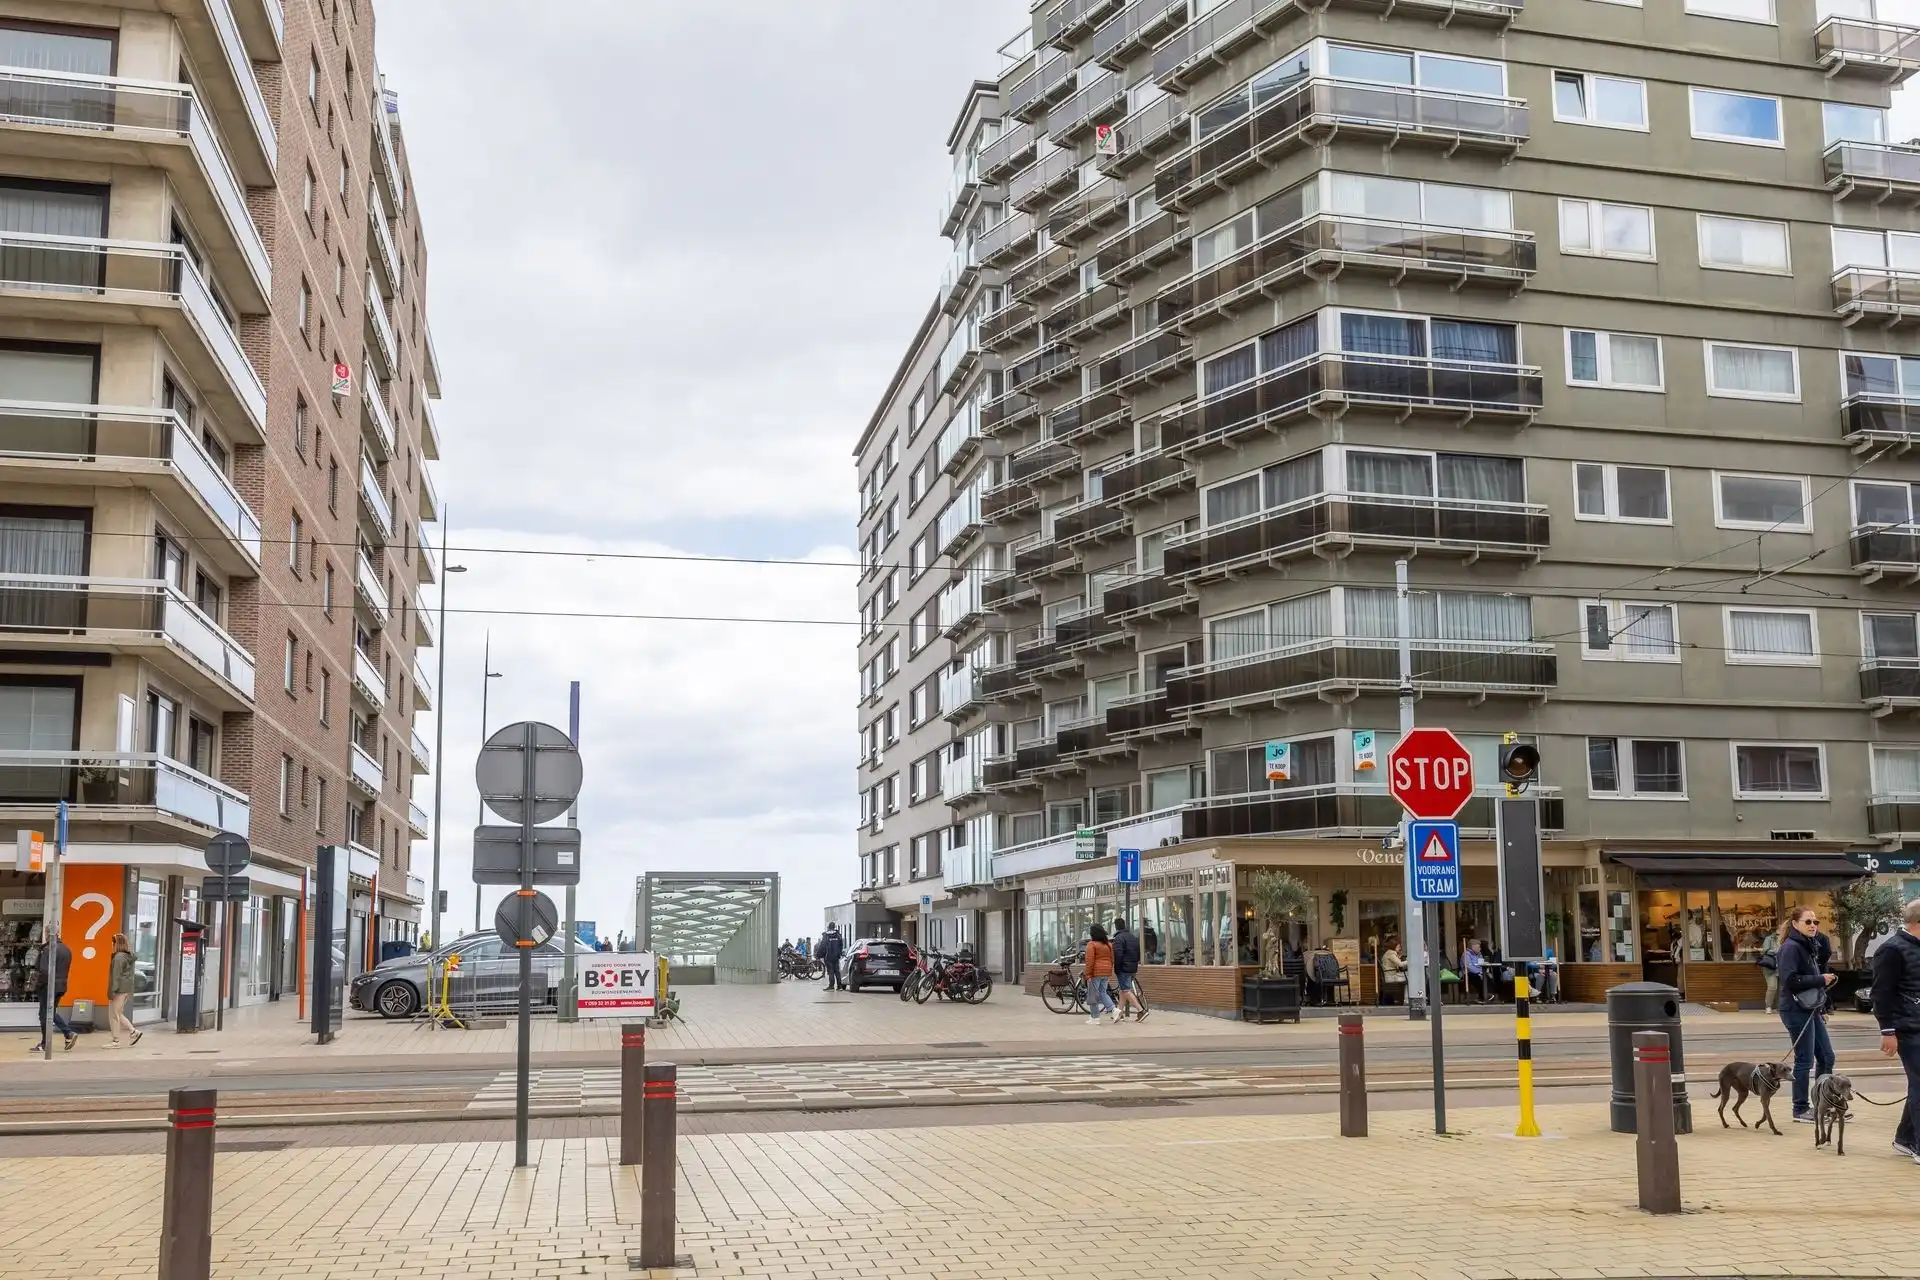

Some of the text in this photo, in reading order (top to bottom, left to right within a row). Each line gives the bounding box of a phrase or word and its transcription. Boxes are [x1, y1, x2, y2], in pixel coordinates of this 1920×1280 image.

[1395, 756, 1469, 791] STOP
[1356, 848, 1404, 864] Vene
[1417, 865, 1456, 875] VOORRANG
[1421, 878, 1454, 894] TRAM
[1736, 876, 1779, 889] Veneziana
[584, 969, 650, 988] BOEY
